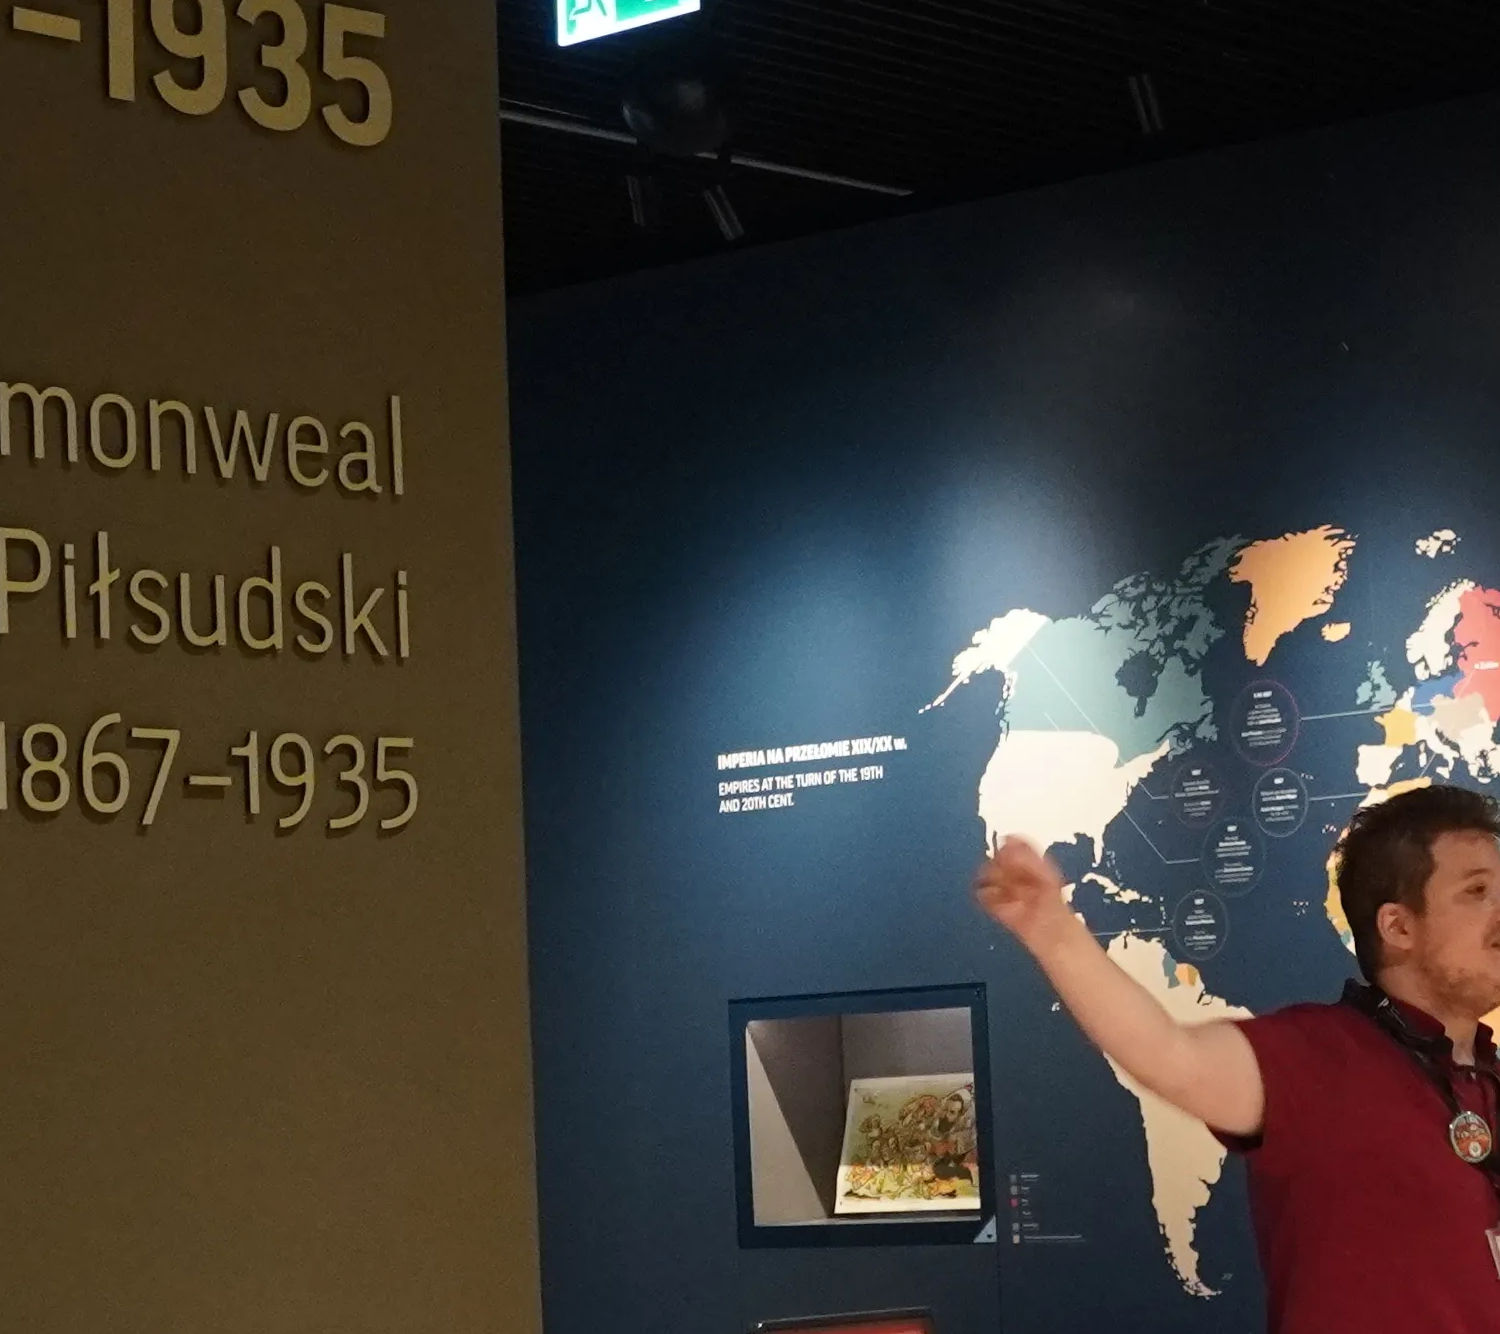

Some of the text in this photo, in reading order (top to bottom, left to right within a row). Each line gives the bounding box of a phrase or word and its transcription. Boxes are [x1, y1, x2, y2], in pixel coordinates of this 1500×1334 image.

[718, 750, 766, 770] IMPERIA
[767, 747, 785, 765] NA
[785, 740, 850, 763] PRZEŁOMIE
[851, 735, 892, 755] XIX/XX
[718, 765, 883, 796] EMPIRES AT THE TURN OF THE 19TH
[719, 792, 794, 813] AND 20TH CENT.
